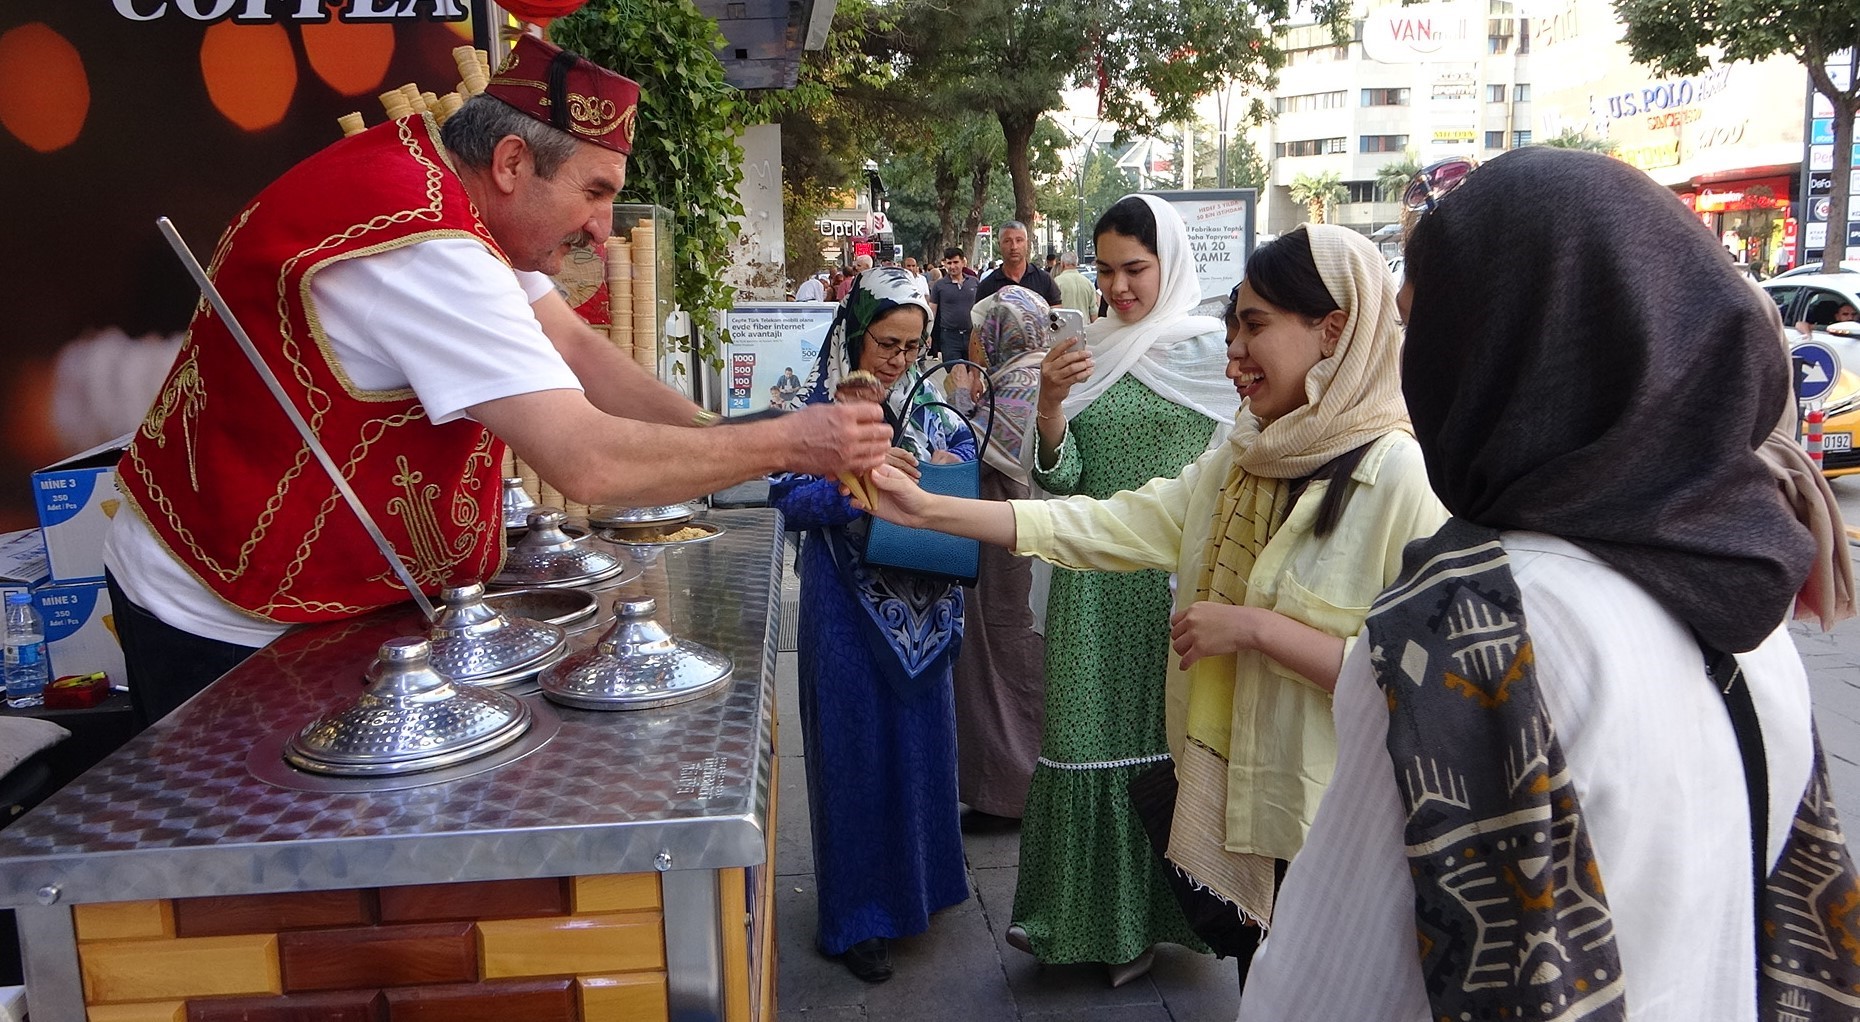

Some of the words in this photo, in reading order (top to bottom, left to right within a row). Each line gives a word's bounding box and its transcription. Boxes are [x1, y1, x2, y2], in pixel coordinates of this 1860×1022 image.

[1811, 179, 1831, 189] DeFa
[1190, 242, 1207, 252] AM
[1211, 241, 1226, 251] 20
[1193, 252, 1231, 262] KAMIZ
[1824, 436, 1849, 448] 0192
[40, 478, 67, 490] MİNE
[68, 479, 77, 488] 3
[52, 494, 69, 502] 350
[42, 594, 68, 606] MİNE
[70, 595, 78, 604] 3
[54, 610, 71, 618] 350
